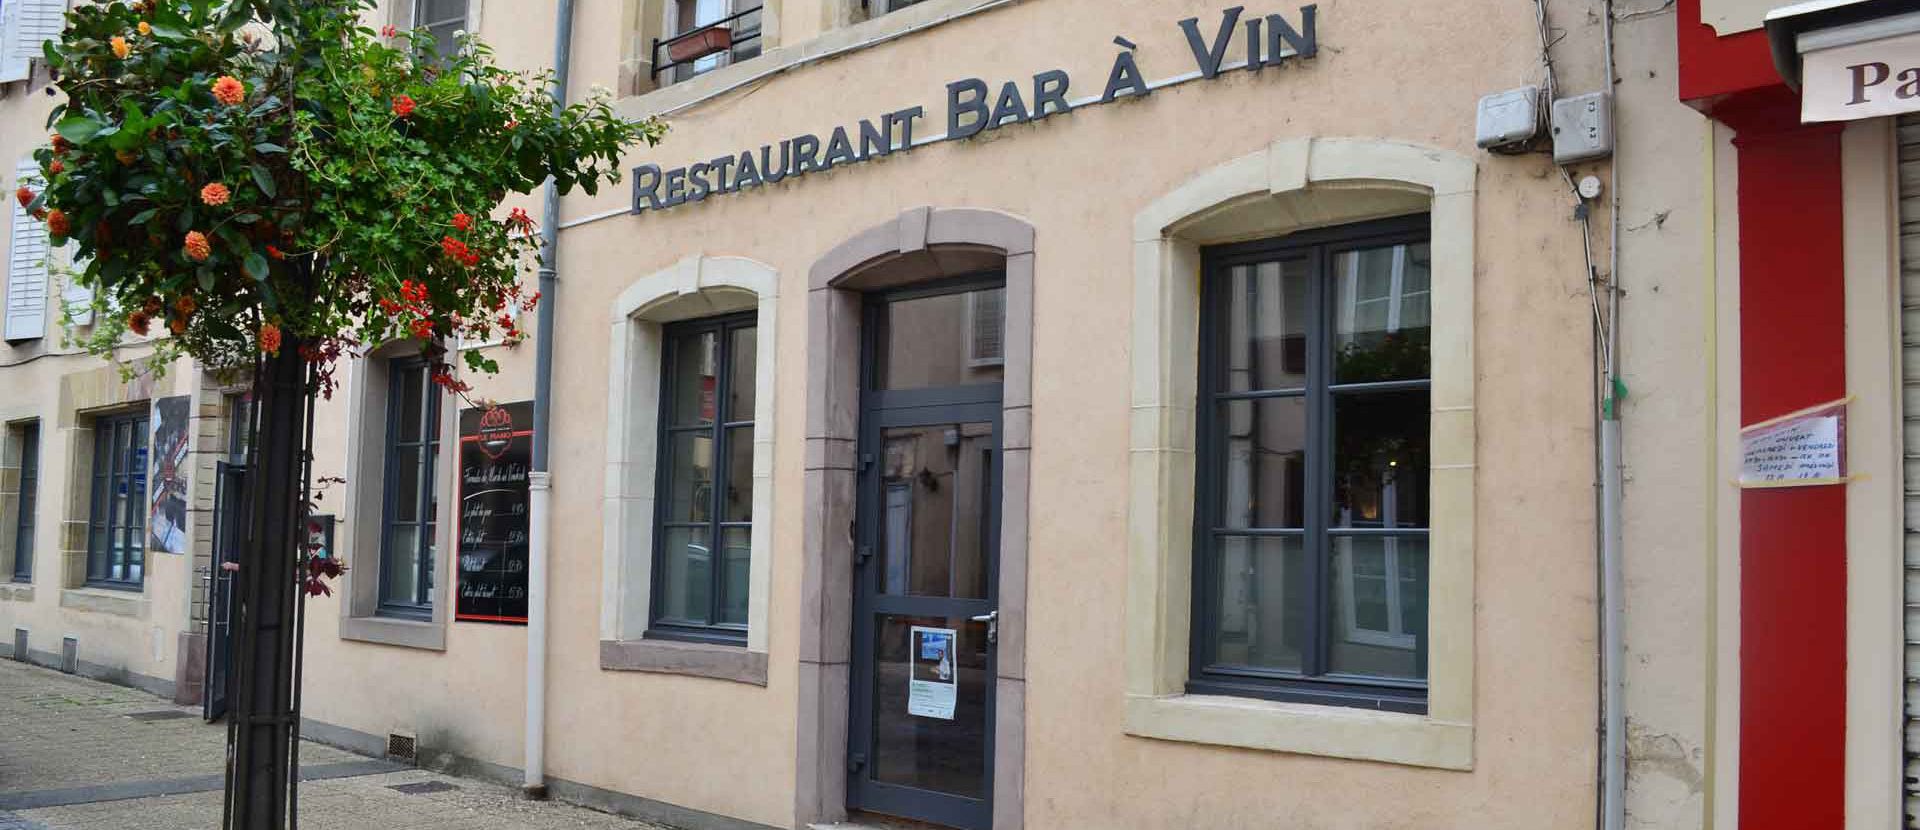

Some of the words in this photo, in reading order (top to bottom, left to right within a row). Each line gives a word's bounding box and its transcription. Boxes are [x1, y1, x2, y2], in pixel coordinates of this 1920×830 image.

[632, 105, 923, 215] RESTAURANT
[945, 69, 1073, 141] BAR
[1101, 35, 1149, 103] À
[1177, 4, 1319, 80] VIN
[1845, 61, 1920, 106] Pa
